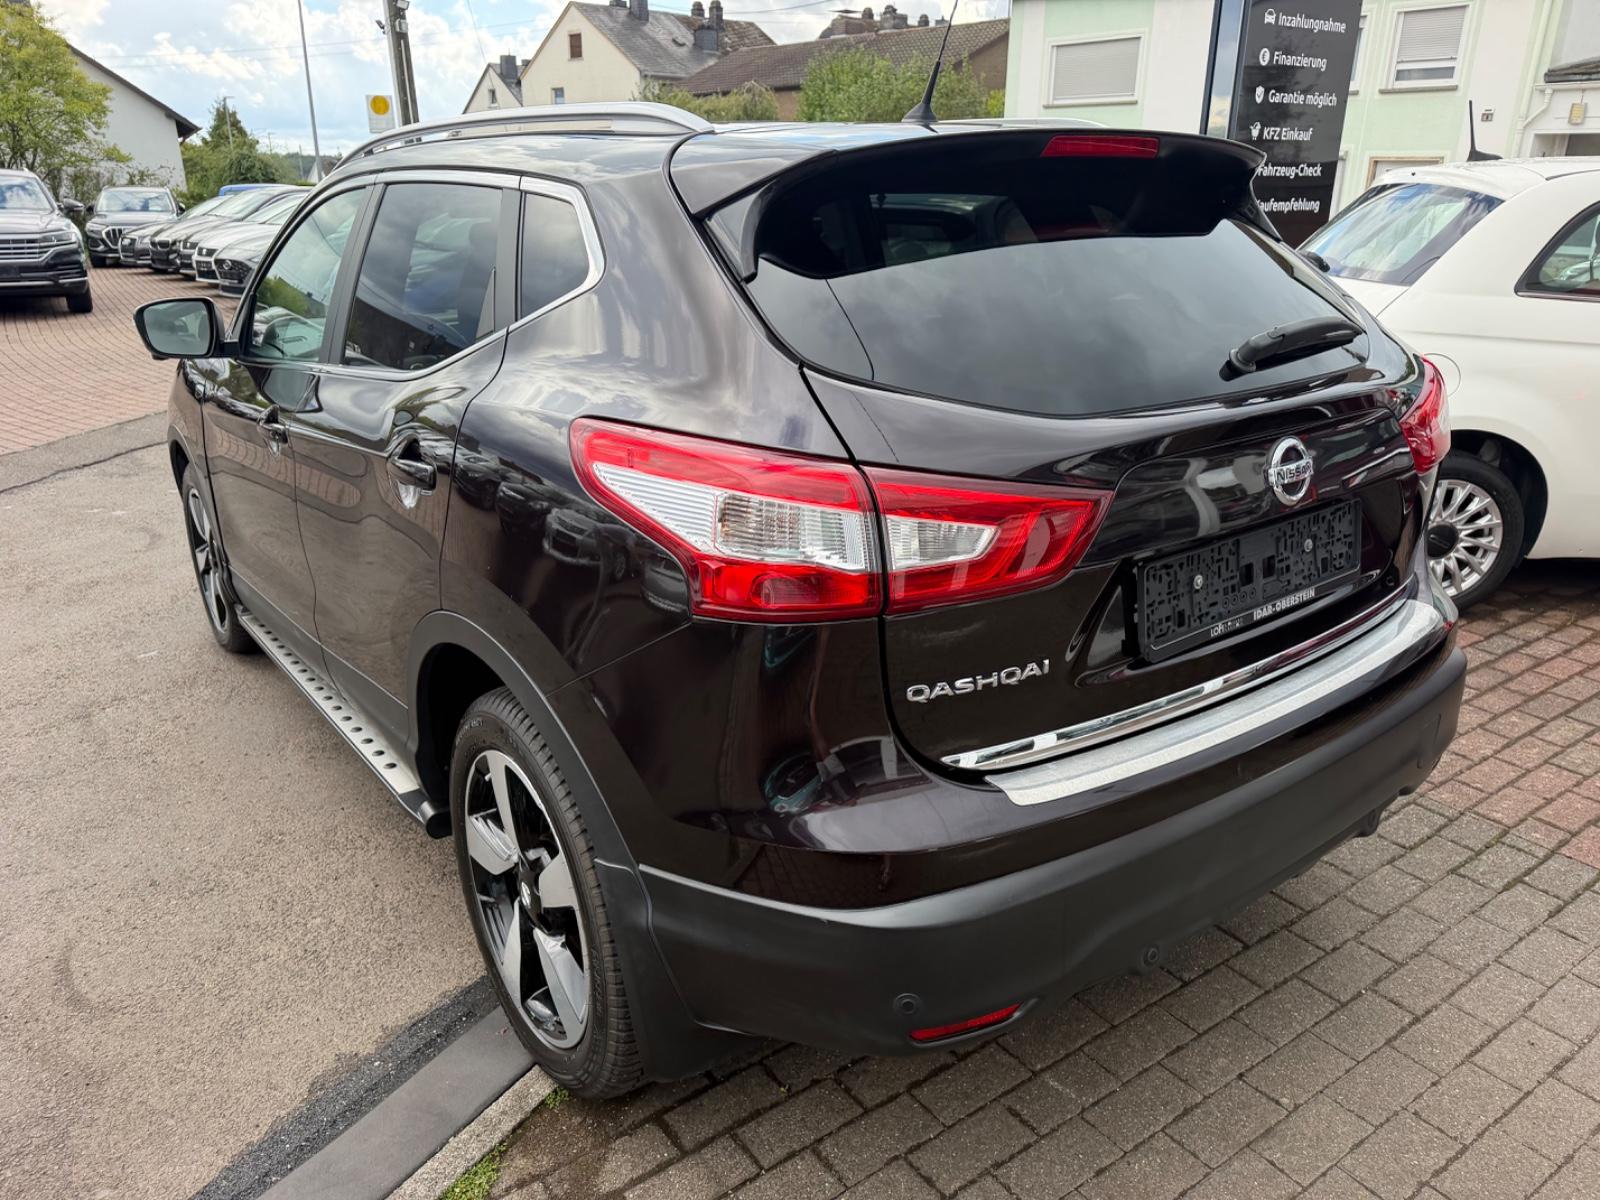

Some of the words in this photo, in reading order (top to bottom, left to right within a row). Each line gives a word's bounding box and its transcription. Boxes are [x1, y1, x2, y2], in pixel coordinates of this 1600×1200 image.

[1278, 12, 1346, 33] Inzahlungnahme
[1273, 51, 1327, 71] Finanzierung
[1268, 89, 1305, 105] Garantie
[1305, 92, 1337, 108] möglich
[1263, 128, 1280, 140] KFZ
[1281, 127, 1313, 141] Einkauf
[1276, 461, 1312, 481] NISSAN
[1253, 587, 1315, 621] IDAR-OBERSTEIN
[906, 659, 1050, 703] QASHQAI
